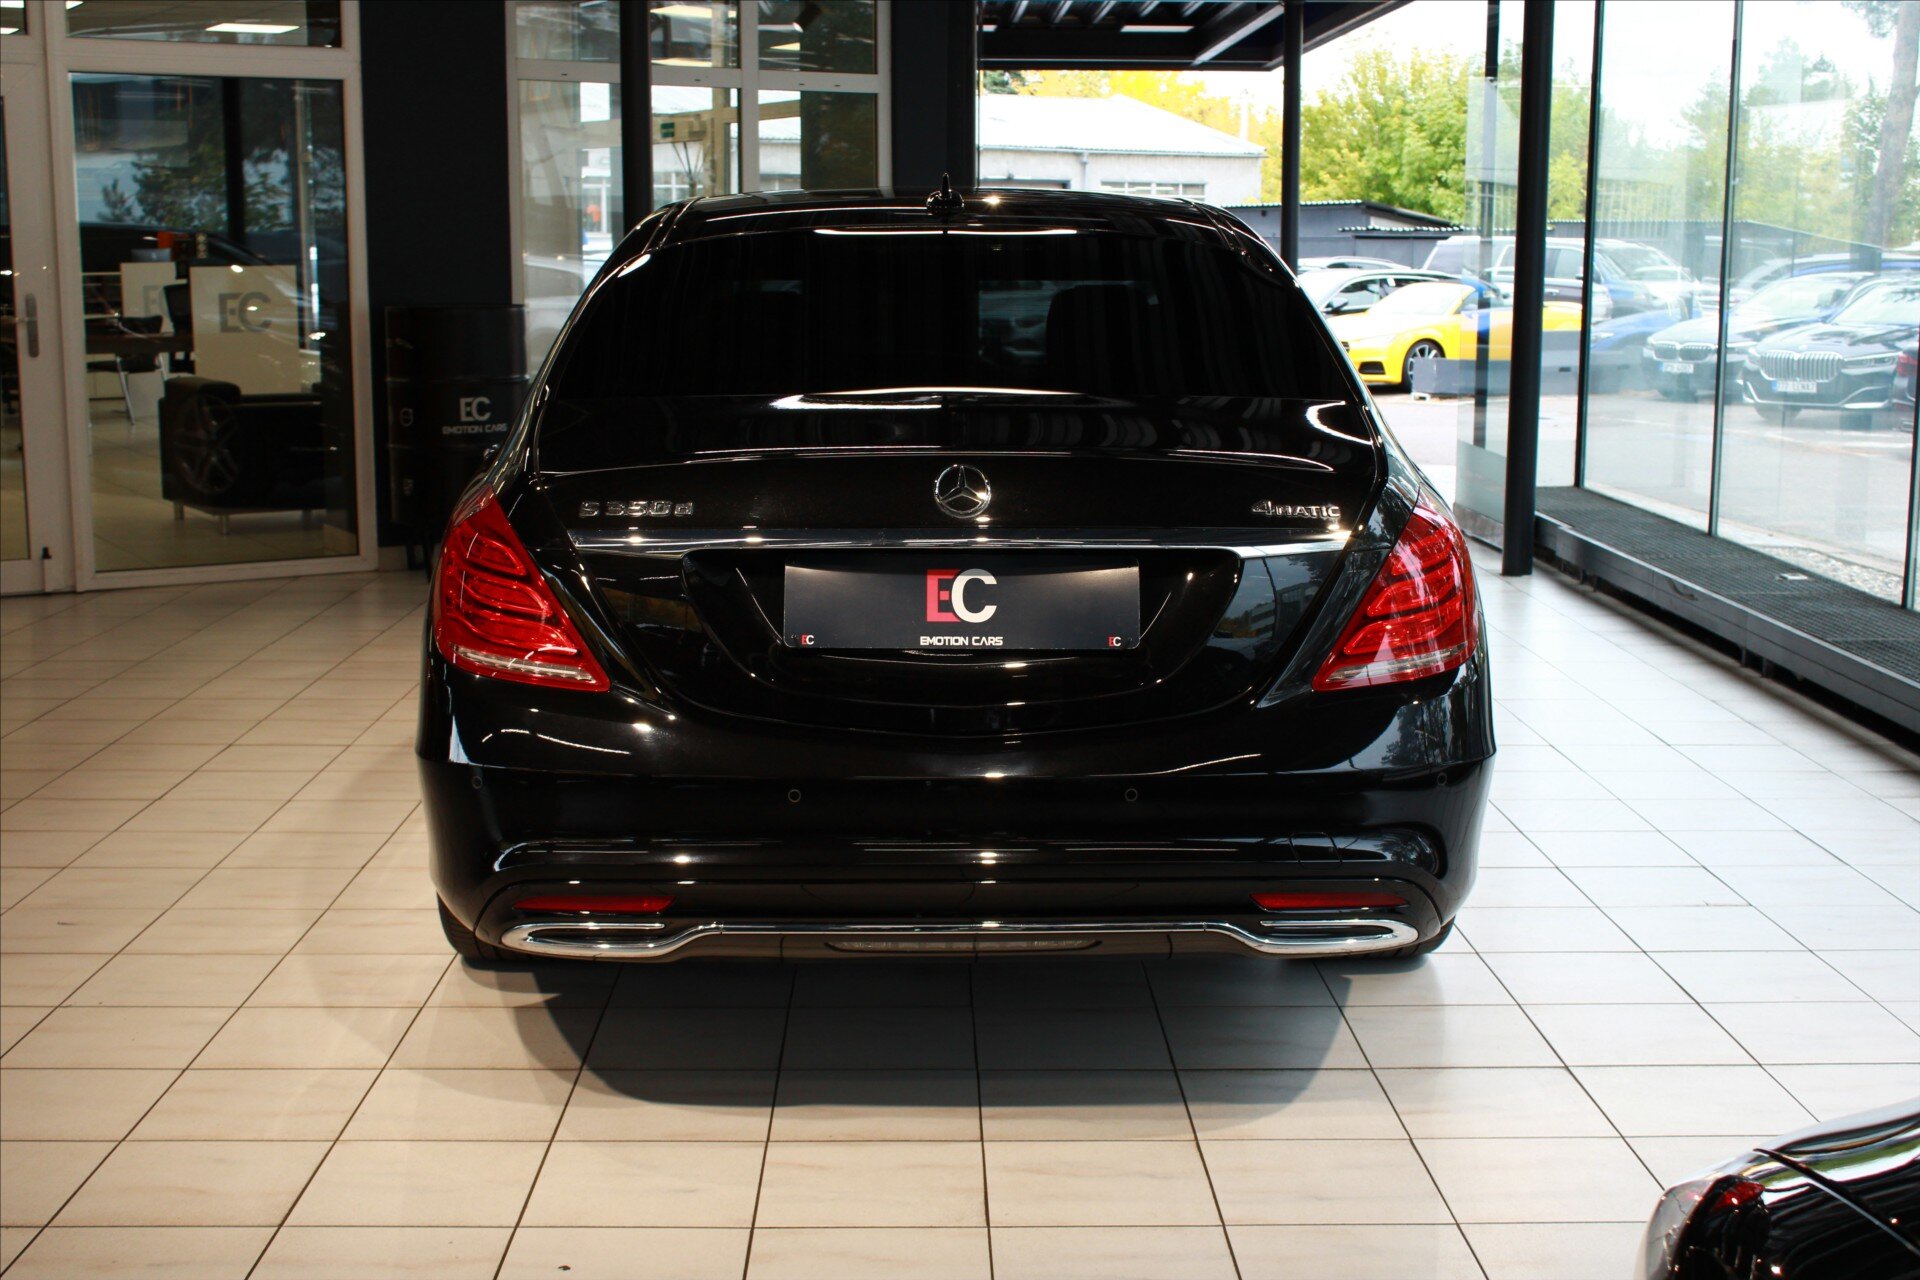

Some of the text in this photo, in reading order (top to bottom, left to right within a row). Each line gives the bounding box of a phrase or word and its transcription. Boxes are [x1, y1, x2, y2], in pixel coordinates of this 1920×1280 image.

[219, 292, 272, 333] EC
[460, 396, 491, 421] EC
[442, 423, 508, 435] EMOTION CARS
[579, 501, 600, 518] S
[926, 568, 998, 624] EC
[801, 634, 815, 646] EC
[919, 635, 1004, 647] EMOTION CARS
[1108, 636, 1122, 647] EC
